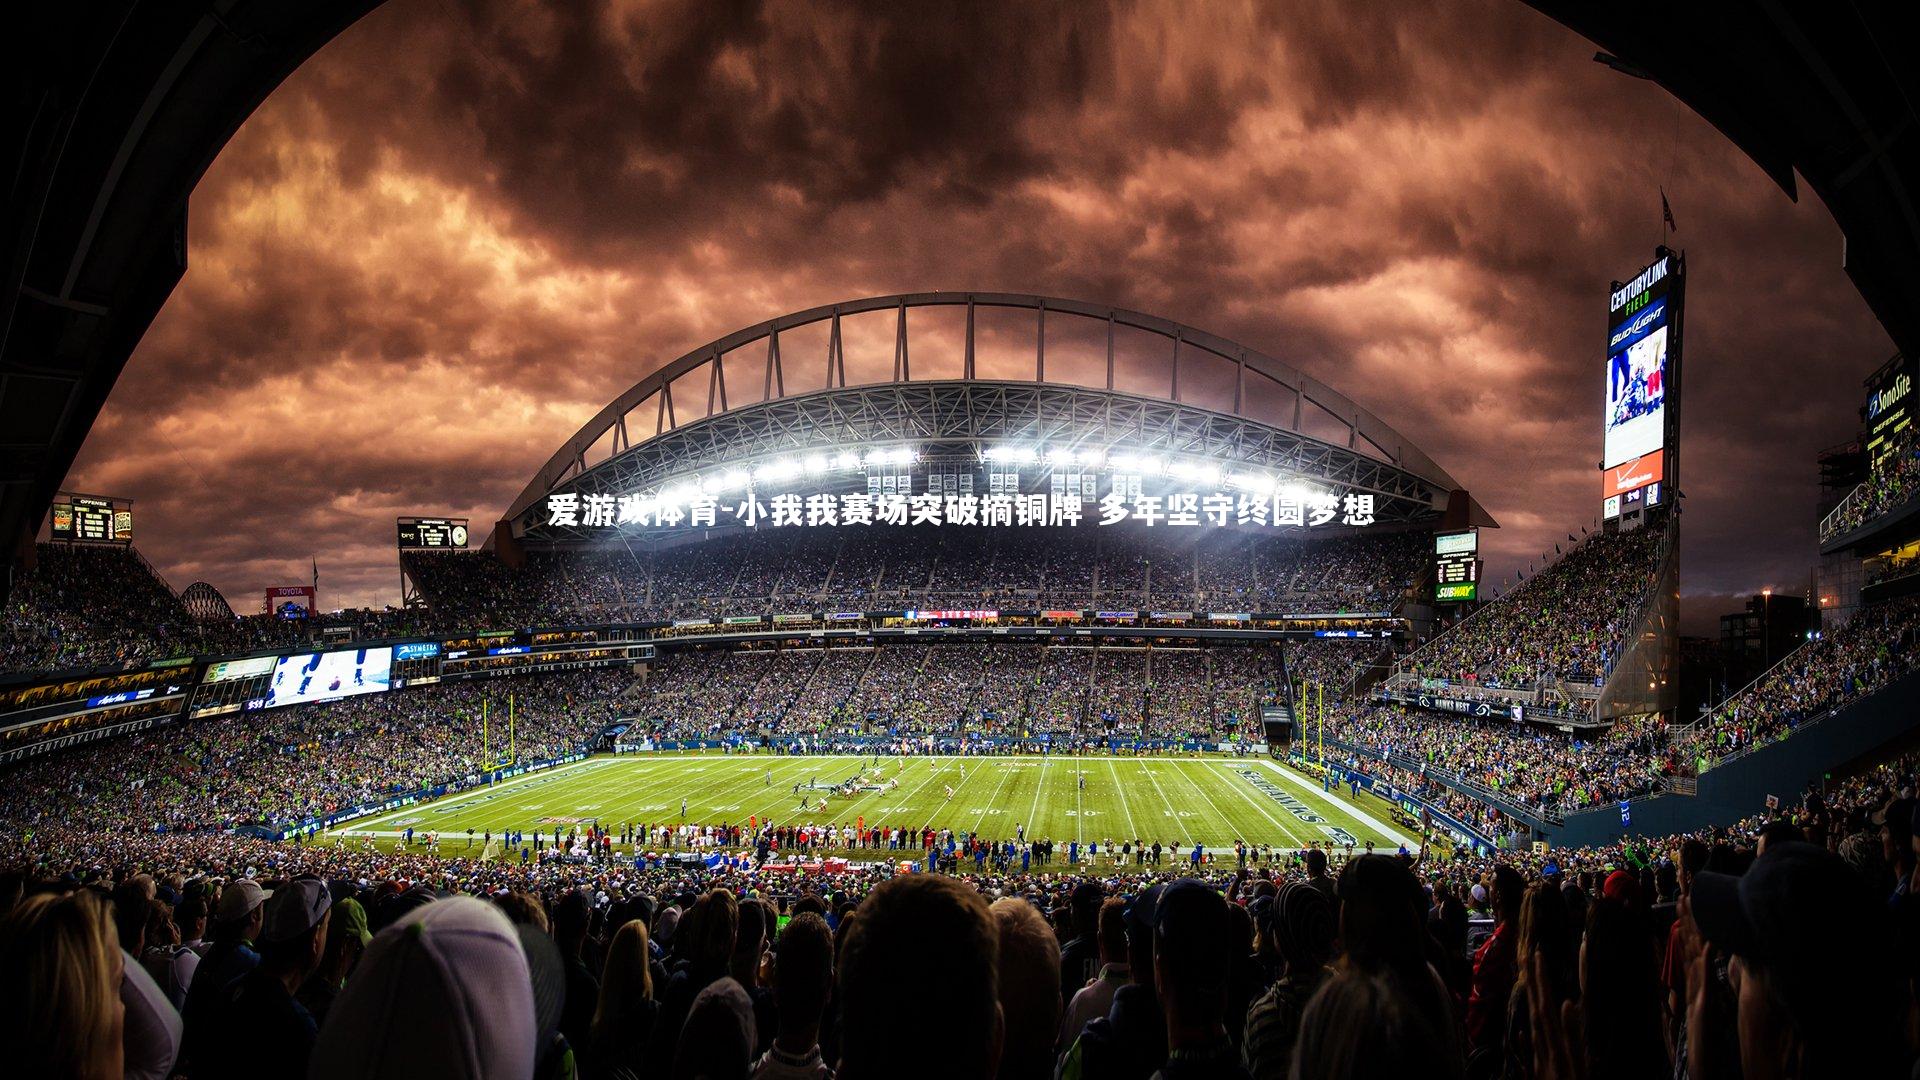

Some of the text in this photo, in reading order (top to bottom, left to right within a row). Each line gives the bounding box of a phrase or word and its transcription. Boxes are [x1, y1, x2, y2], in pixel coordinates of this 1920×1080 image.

[1610, 256, 1669, 313] CENTURYLINK
[1626, 290, 1650, 316] FIELD
[1610, 305, 1665, 347] BUD LIGHT
[1878, 373, 1912, 414] SonoSite
[1872, 407, 1905, 435] DEFENSE
[1437, 585, 1474, 598] SUBWAY
[410, 644, 437, 653] SYMETRA
[489, 668, 516, 677] HOME
[538, 664, 555, 672] THE
[560, 662, 583, 670] 12TH
[1434, 698, 1456, 711] HAWKS
[9, 750, 24, 762] TO
[30, 728, 112, 756] CENTURYLINK
[117, 720, 153, 735] FIELD
